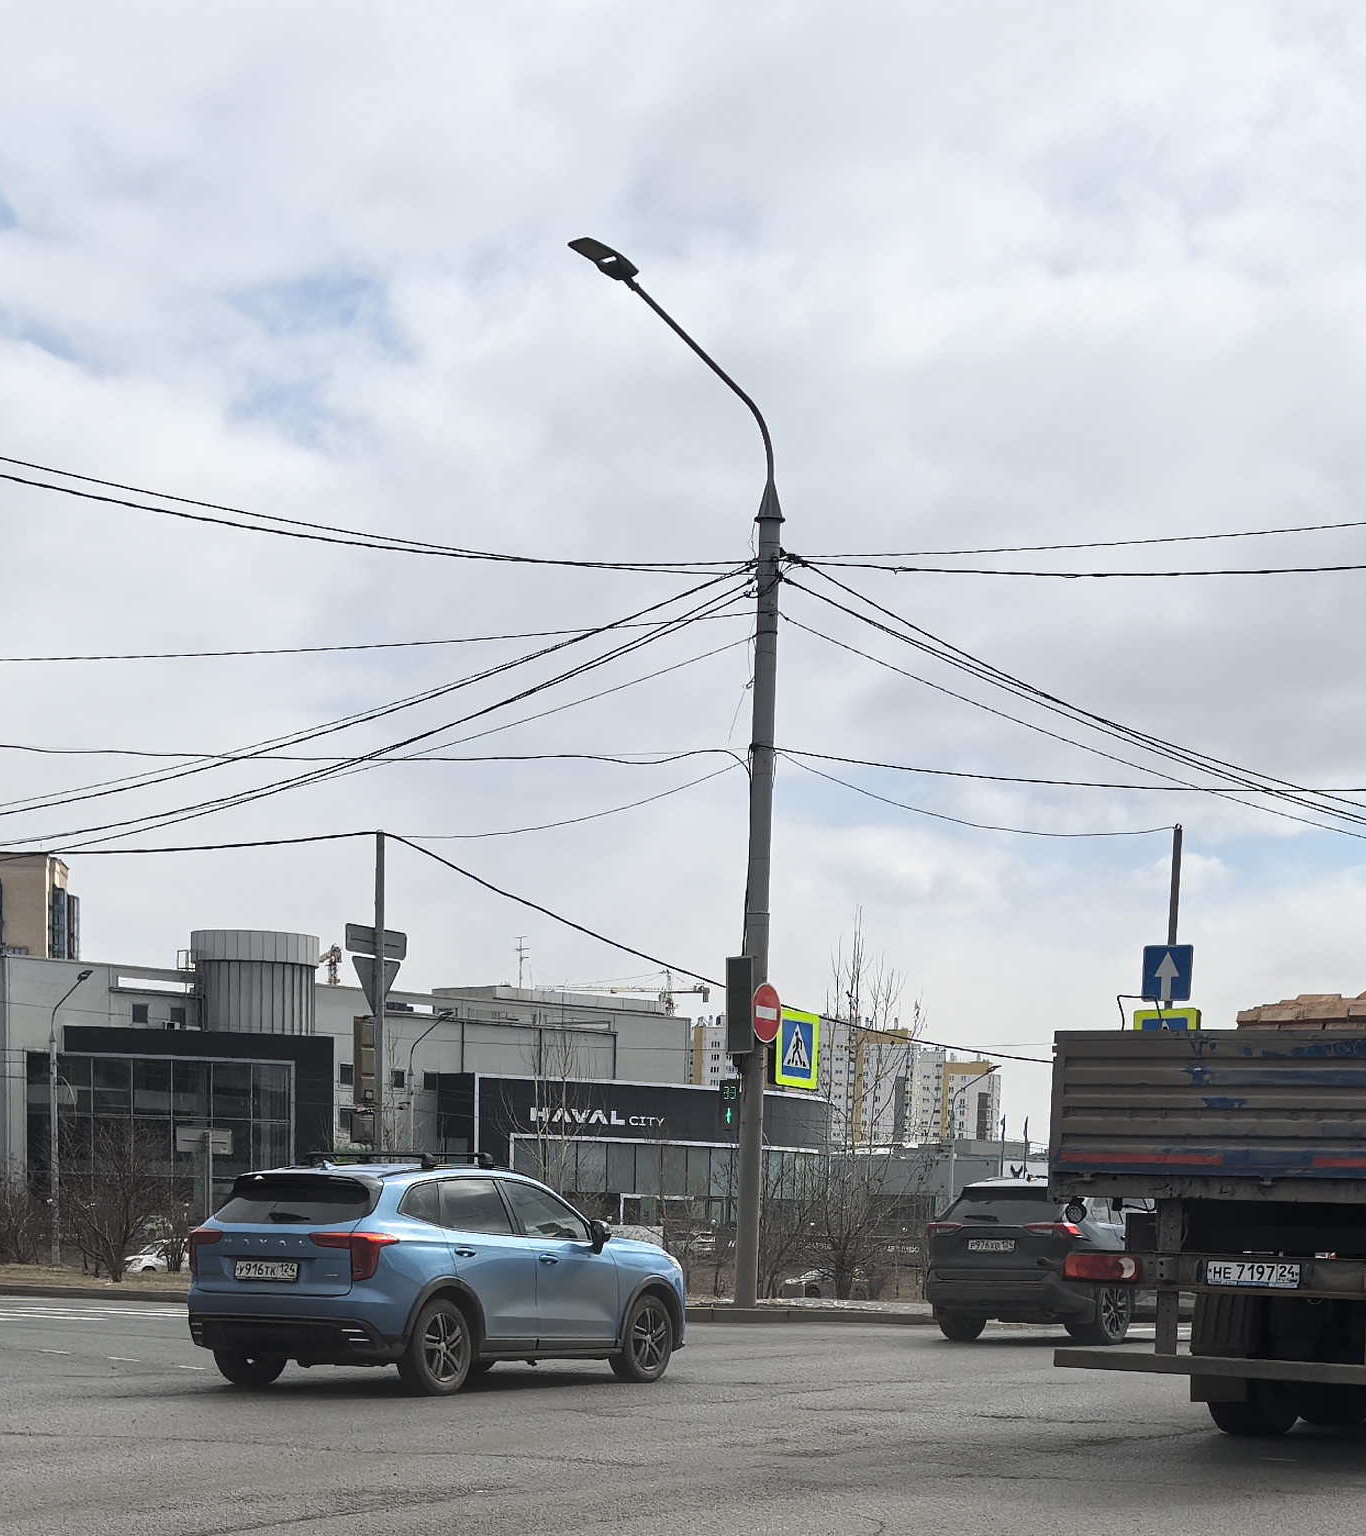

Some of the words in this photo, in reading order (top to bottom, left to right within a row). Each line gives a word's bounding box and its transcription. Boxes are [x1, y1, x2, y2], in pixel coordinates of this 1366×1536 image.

[529, 1107, 626, 1126] HAVAL
[628, 1115, 665, 1127] CITY
[279, 1263, 295, 1273] 124
[1236, 1264, 1275, 1281] 7197
[1278, 1265, 1295, 1278] 24
